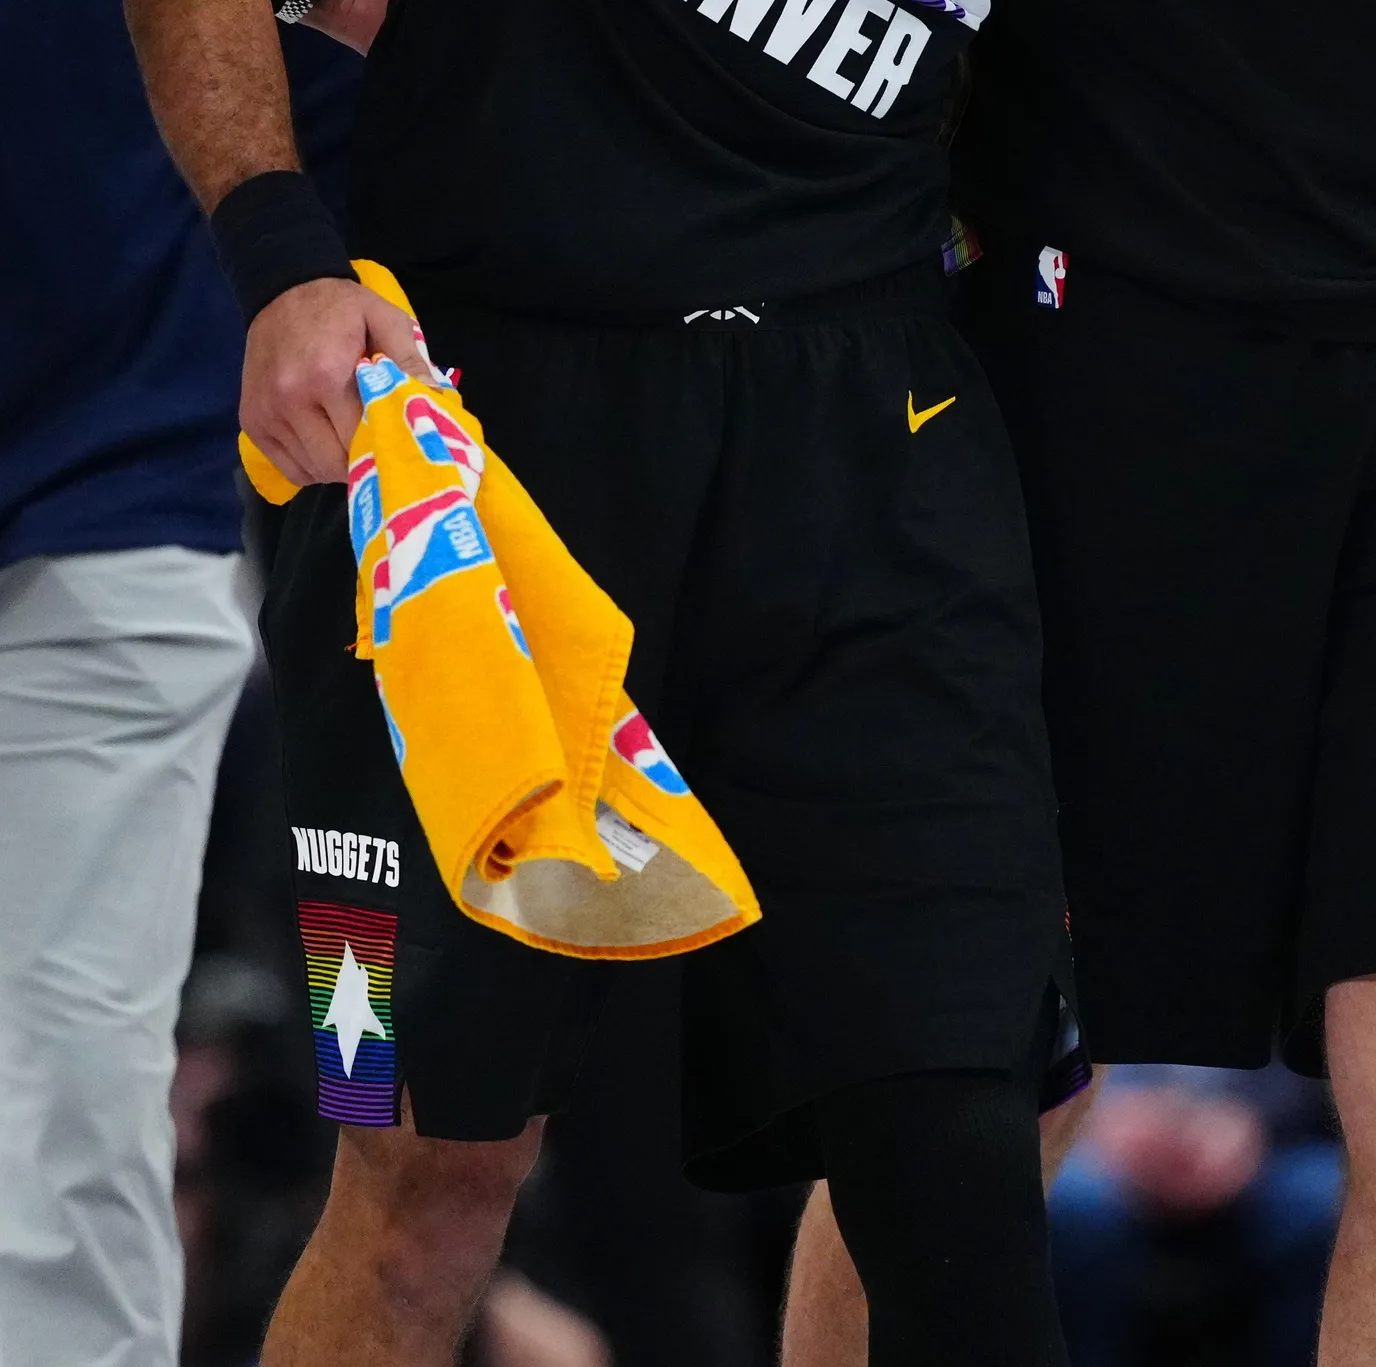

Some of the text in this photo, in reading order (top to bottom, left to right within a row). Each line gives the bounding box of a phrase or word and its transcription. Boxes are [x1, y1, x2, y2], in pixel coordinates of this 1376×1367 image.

[1037, 291, 1052, 304] NBA
[443, 511, 483, 560] NBA
[291, 826, 400, 888] NUGGETS
